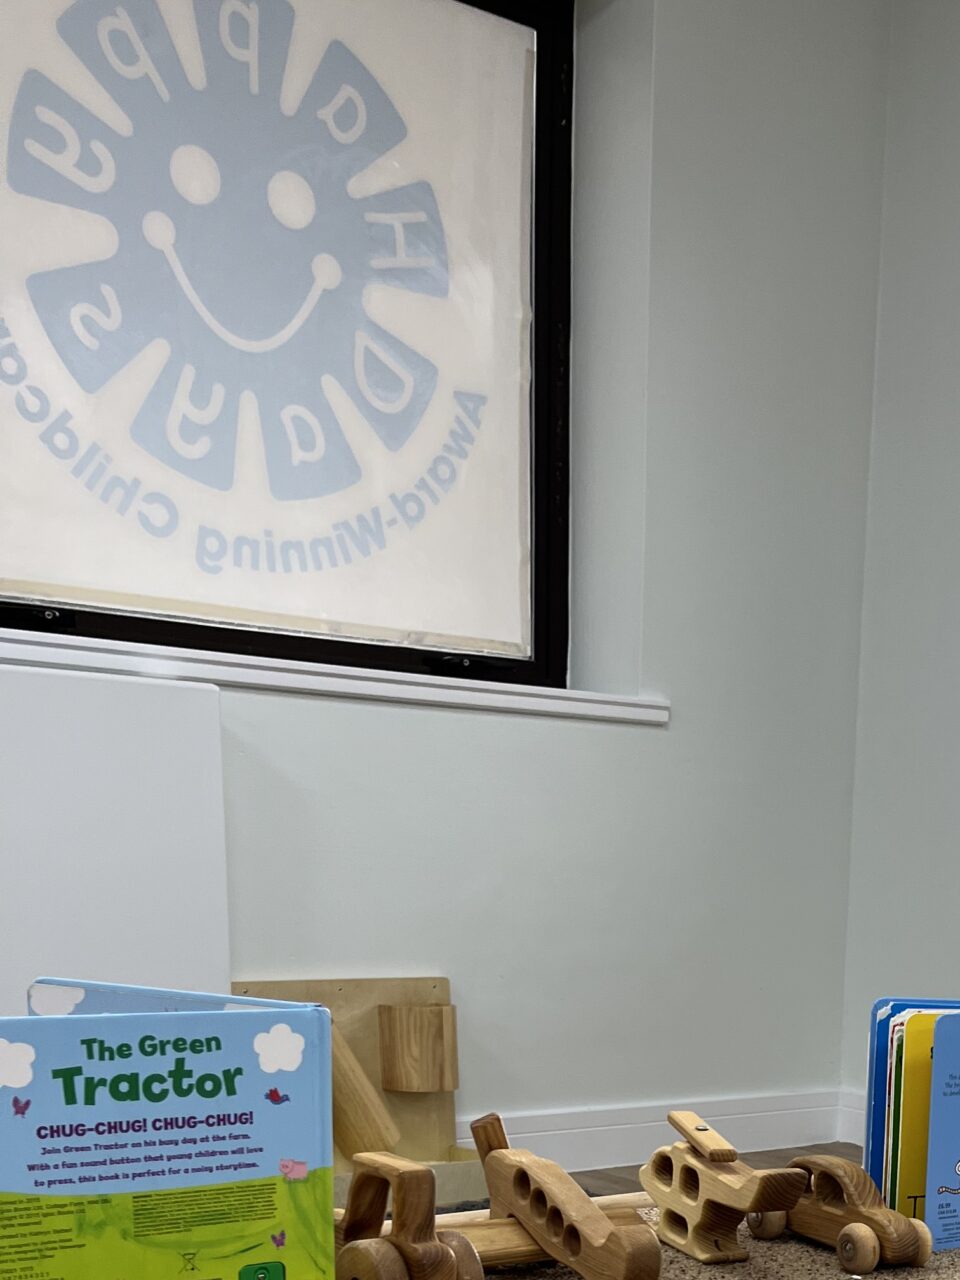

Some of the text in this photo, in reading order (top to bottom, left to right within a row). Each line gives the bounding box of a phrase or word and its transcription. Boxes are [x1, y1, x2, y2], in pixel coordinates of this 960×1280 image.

[80, 1034, 223, 1062] The Green
[52, 1057, 244, 1106] Tractor
[36, 1110, 254, 1140] CHUG-CHUG! CHUG-CHUG!
[41, 1146, 61, 1155] Join
[63, 1145, 92, 1153] Green
[94, 1142, 129, 1151] Tractor
[144, 1139, 156, 1147] his
[158, 1138, 179, 1147] busy
[181, 1136, 197, 1145] day
[212, 1134, 227, 1142] the
[27, 1162, 51, 1172] With
[62, 1160, 77, 1169] fun
[80, 1158, 107, 1168] sound
[109, 1156, 142, 1166] button
[144, 1153, 164, 1162] that
[166, 1152, 193, 1162] young
[194, 1149, 229, 1158] children
[230, 1147, 245, 1155] will
[246, 1146, 264, 1154] love
[34, 1178, 45, 1187] to
[78, 1174, 96, 1184] this
[98, 1172, 119, 1182] book
[122, 1171, 130, 1180] is
[132, 1168, 166, 1181] perfect
[168, 1166, 181, 1176] for
[191, 1164, 213, 1174] noisy
